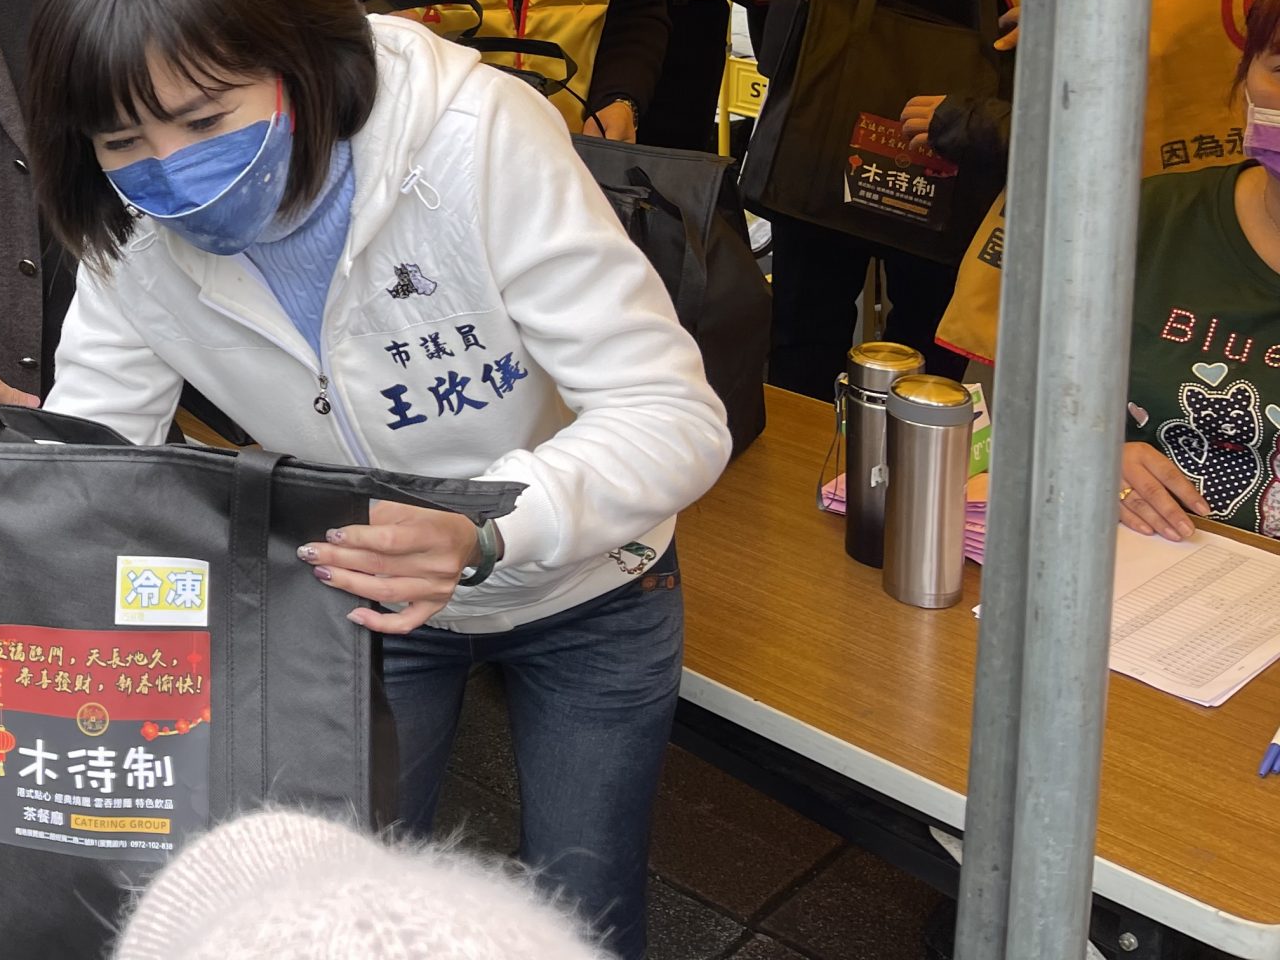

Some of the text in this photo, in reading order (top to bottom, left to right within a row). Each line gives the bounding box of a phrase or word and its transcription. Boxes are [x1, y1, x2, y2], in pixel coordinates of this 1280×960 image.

[750, 82, 768, 98] S
[384, 324, 486, 369] 市議員
[380, 352, 528, 430] 王欣儀
[125, 569, 204, 608] 冷凍
[18, 739, 175, 793] 木待制
[23, 806, 64, 826] 茶餐廳
[74, 816, 167, 830] CATERING GROUP
